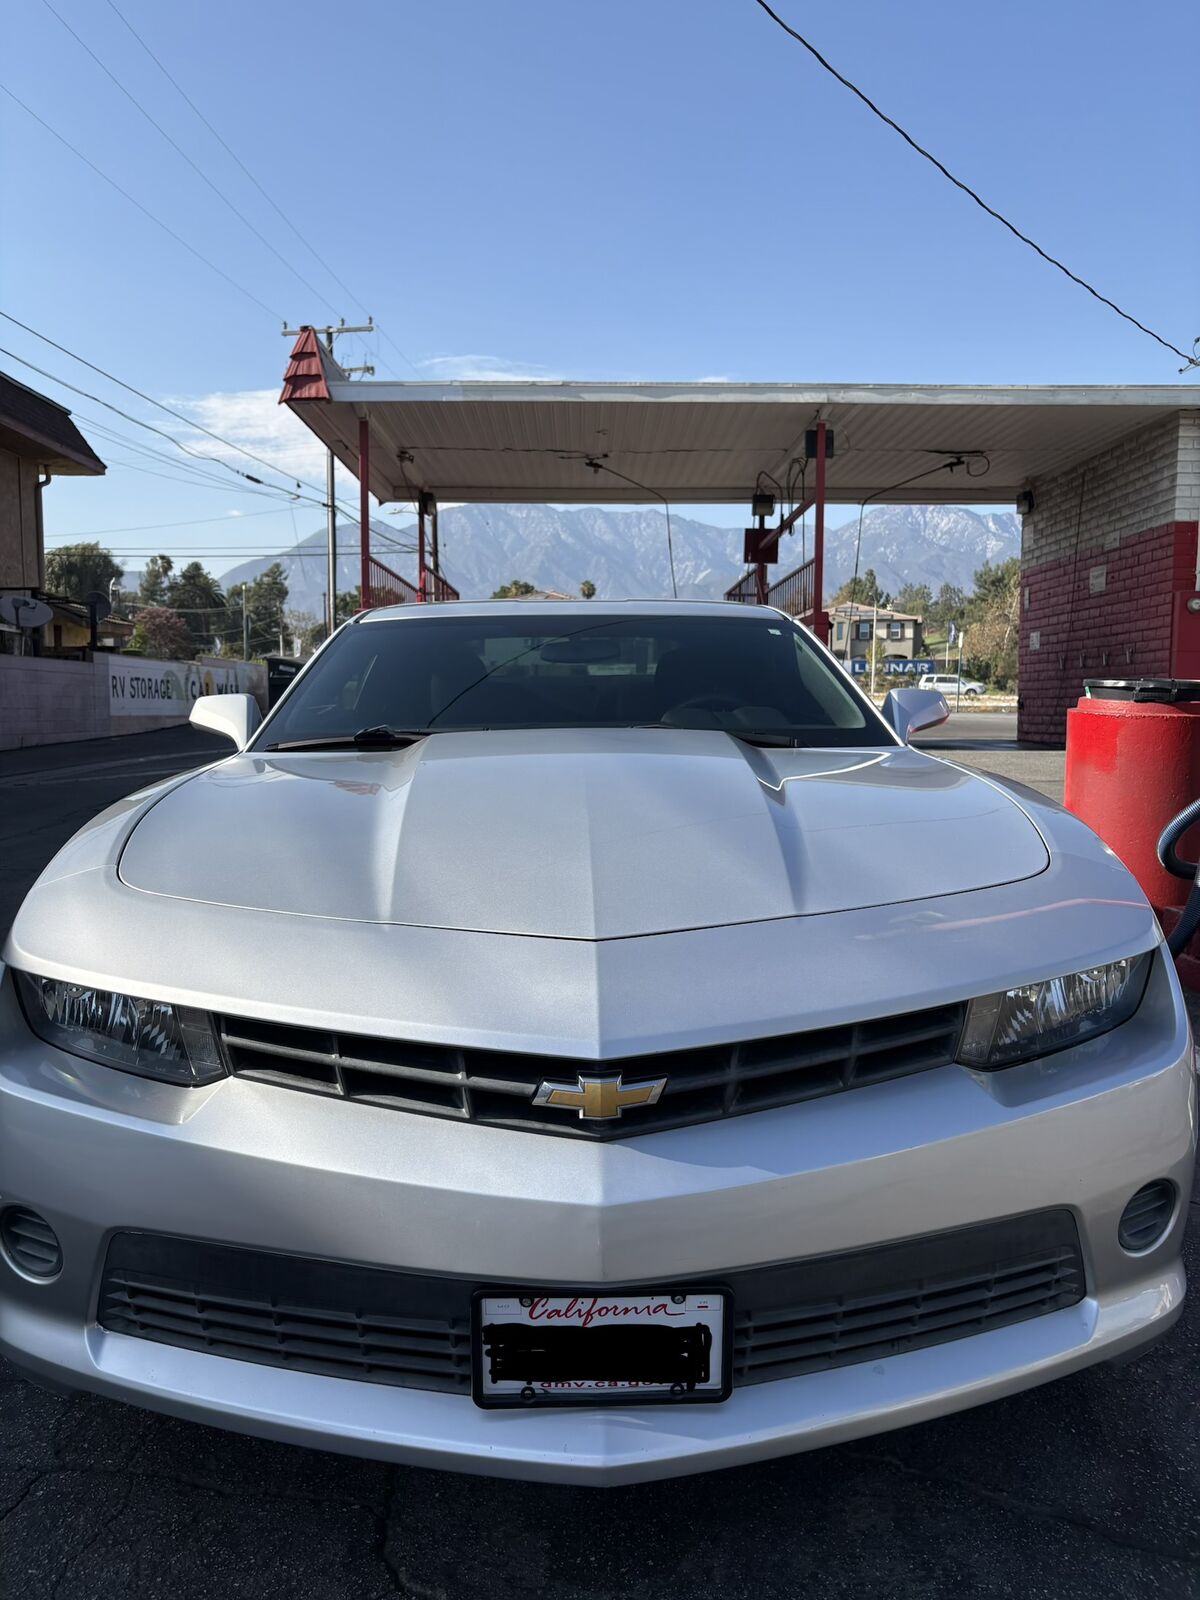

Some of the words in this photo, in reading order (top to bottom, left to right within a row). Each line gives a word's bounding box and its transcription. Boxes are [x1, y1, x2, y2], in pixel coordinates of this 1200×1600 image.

[111, 675, 125, 699] RV
[129, 677, 173, 700] STORAGE
[528, 1297, 685, 1327] California
